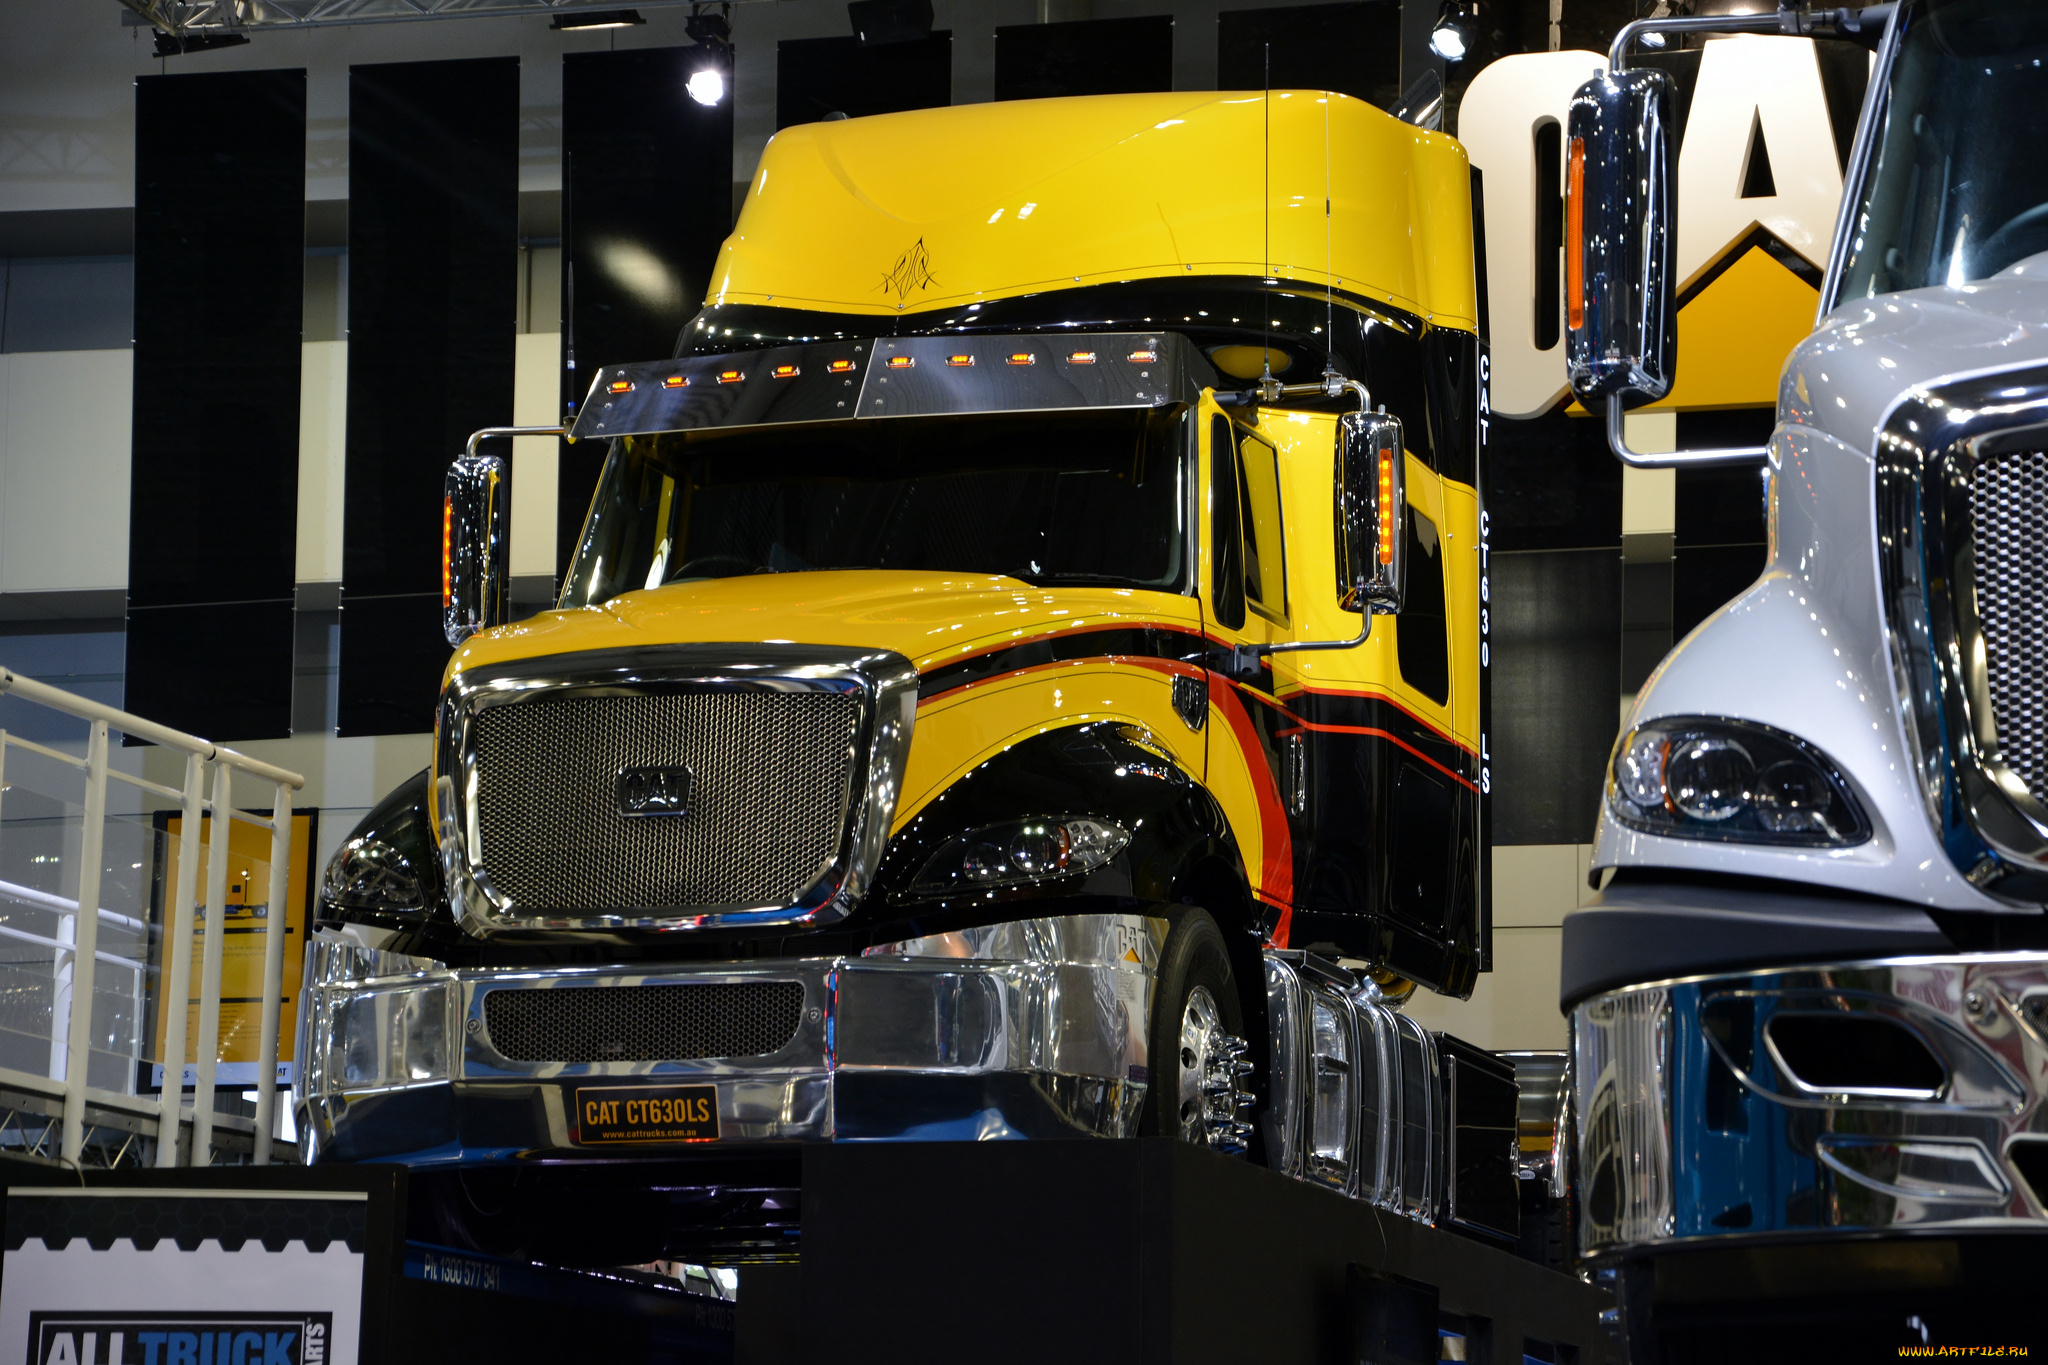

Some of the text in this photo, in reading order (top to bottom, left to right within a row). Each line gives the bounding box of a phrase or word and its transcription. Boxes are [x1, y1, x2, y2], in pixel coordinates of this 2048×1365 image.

[1458, 33, 1876, 420] CA
[1480, 354, 1491, 794] CAT CT630 LS
[585, 1098, 710, 1126] CAT CT630LS
[602, 1129, 697, 1139] www.cattrucks.com.au
[440, 1256, 463, 1284] 1300
[464, 1260, 482, 1287] 577
[483, 1263, 501, 1291] 541
[138, 1332, 297, 1365] TRUCK
